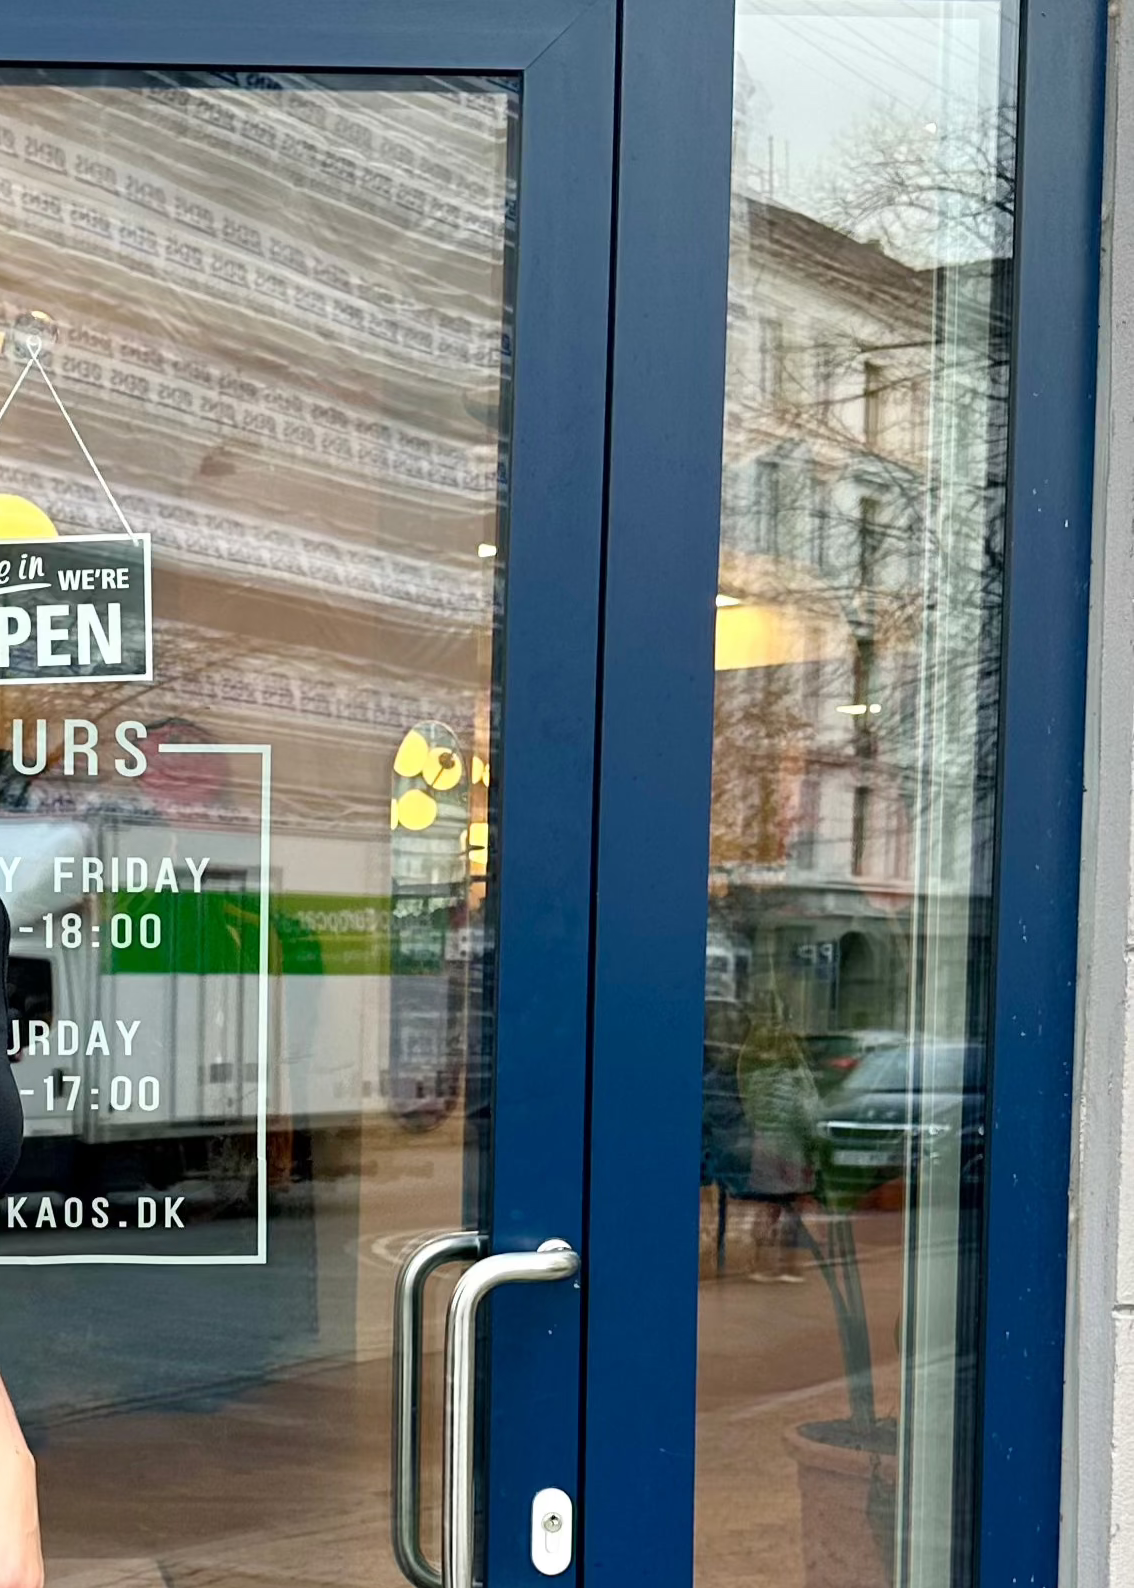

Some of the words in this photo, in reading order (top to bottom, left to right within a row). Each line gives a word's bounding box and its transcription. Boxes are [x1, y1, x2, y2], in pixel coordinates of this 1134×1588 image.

[18, 553, 46, 581] in
[57, 568, 130, 591] WE'RE
[54, 857, 211, 893] FRIDAY
